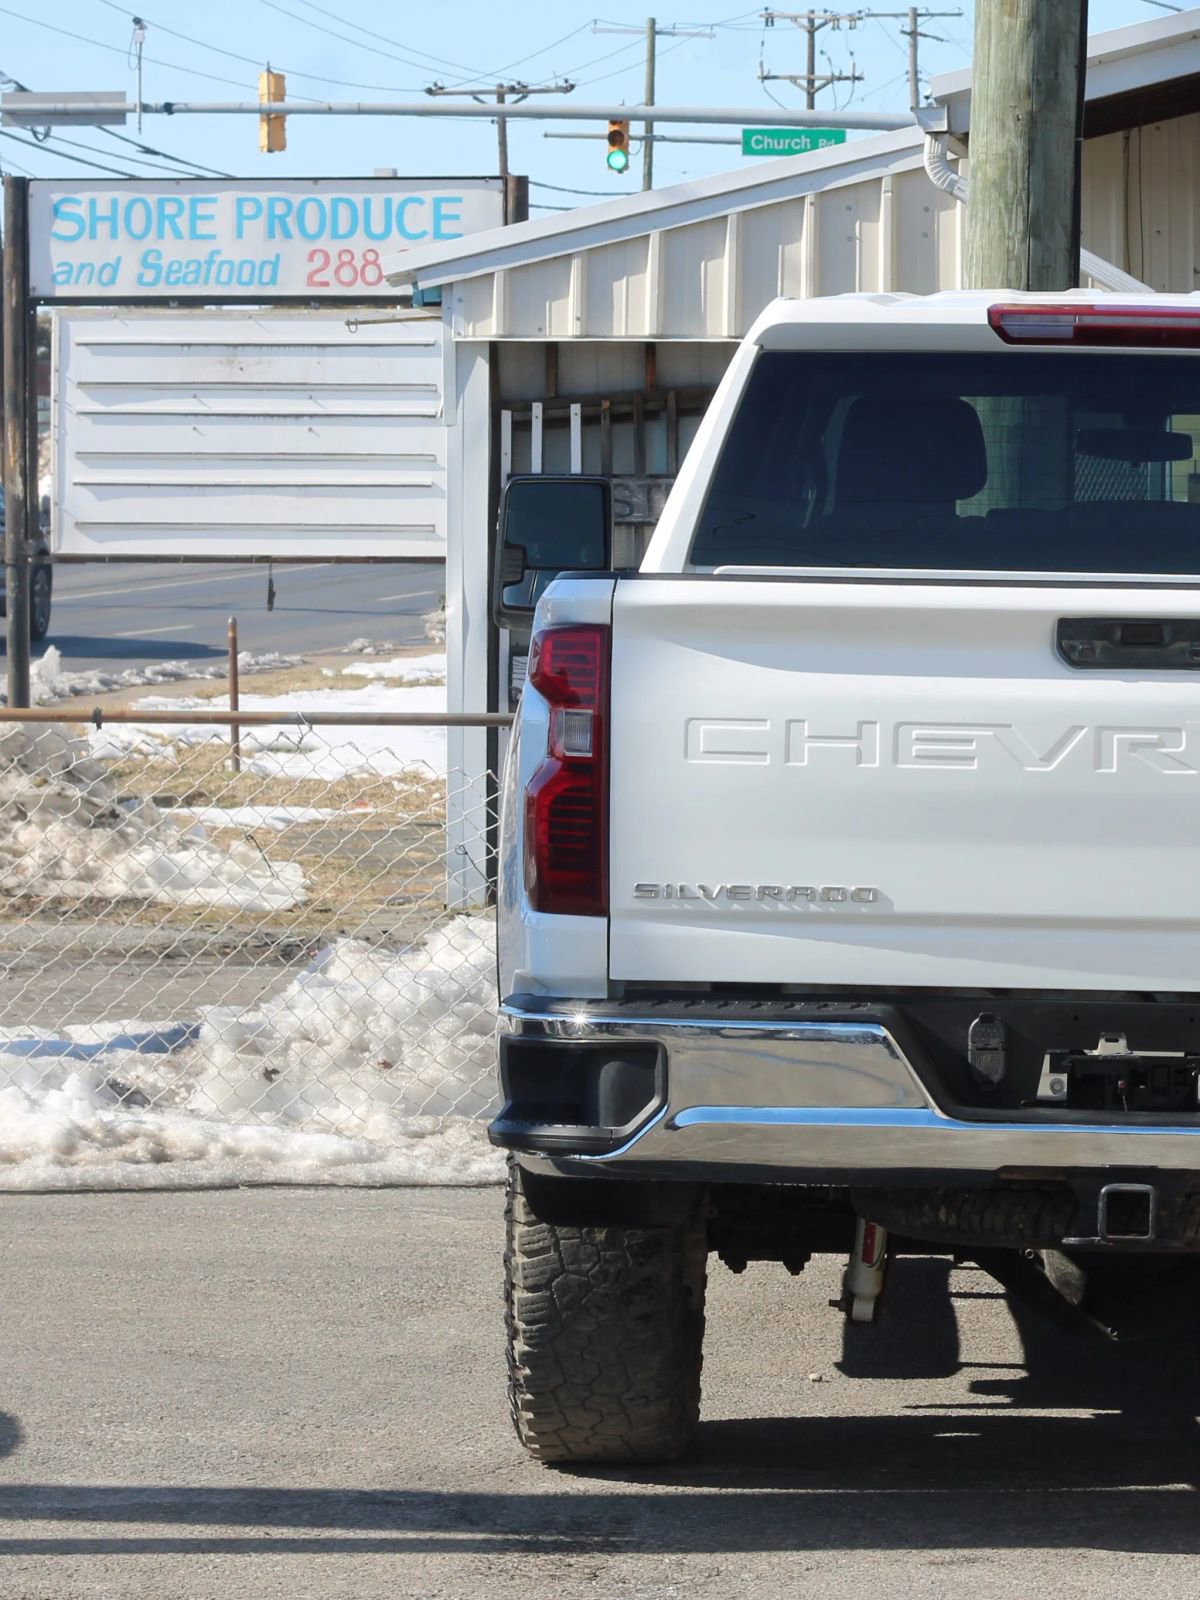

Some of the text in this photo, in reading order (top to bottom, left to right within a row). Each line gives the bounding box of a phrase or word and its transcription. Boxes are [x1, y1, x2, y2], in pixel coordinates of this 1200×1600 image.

[751, 135, 811, 150] Church
[51, 196, 464, 242] SHORE PRODUCE
[51, 247, 385, 287] and Seafood 288
[633, 883, 879, 903] SILVERADO
